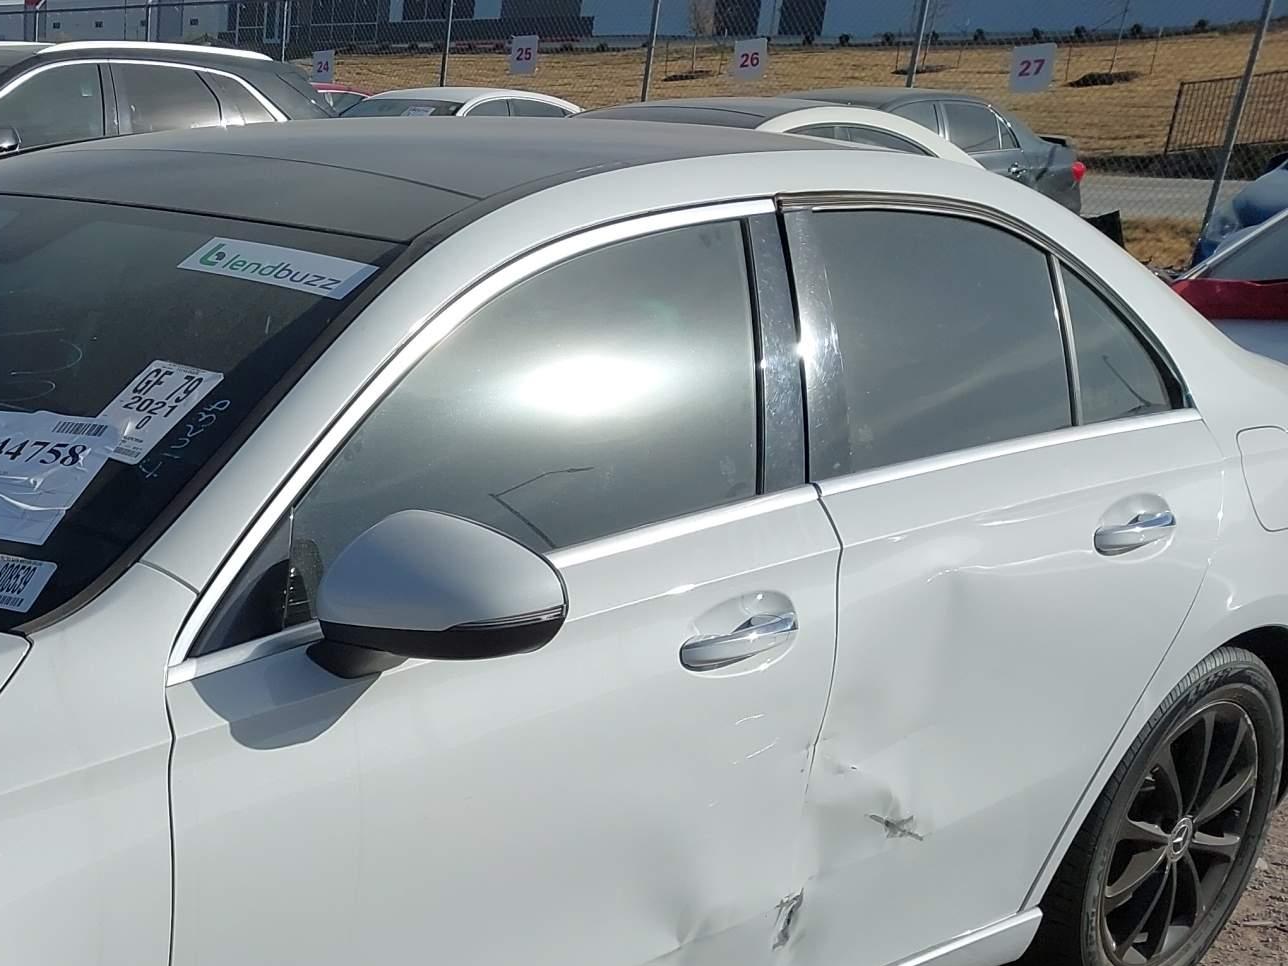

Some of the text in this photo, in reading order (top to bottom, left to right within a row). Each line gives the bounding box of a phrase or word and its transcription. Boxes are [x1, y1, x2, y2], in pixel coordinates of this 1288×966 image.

[516, 48, 531, 61] 25
[739, 52, 759, 68] 26
[316, 61, 329, 73] 24
[1018, 58, 1045, 77] 27
[222, 253, 342, 290] lendbuzz
[132, 368, 174, 396] GF
[165, 375, 204, 404] 79
[123, 395, 179, 418] 2021
[135, 415, 152, 430] 0
